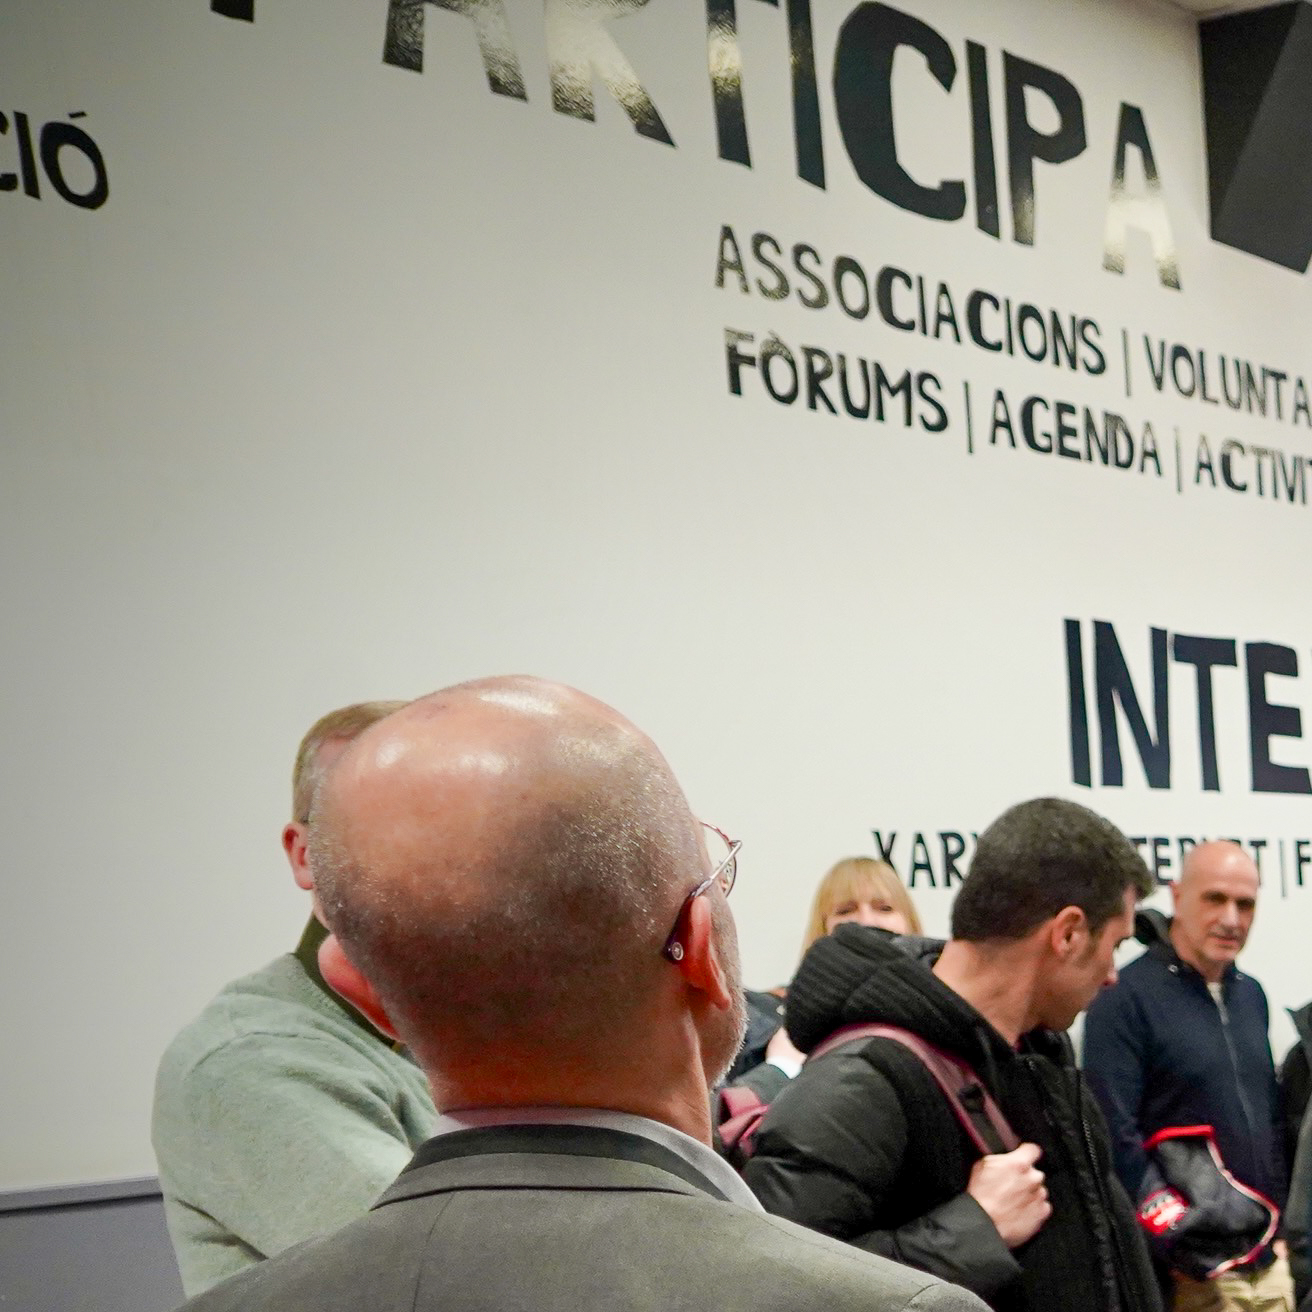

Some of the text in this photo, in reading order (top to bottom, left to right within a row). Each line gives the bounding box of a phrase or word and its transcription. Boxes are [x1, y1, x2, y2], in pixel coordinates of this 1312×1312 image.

[210, 0, 1183, 291] RTICIPA
[714, 224, 1106, 376] ASSOCIACIONS
[724, 328, 948, 433] FÒRUMS
[988, 388, 1163, 478] AGENDA
